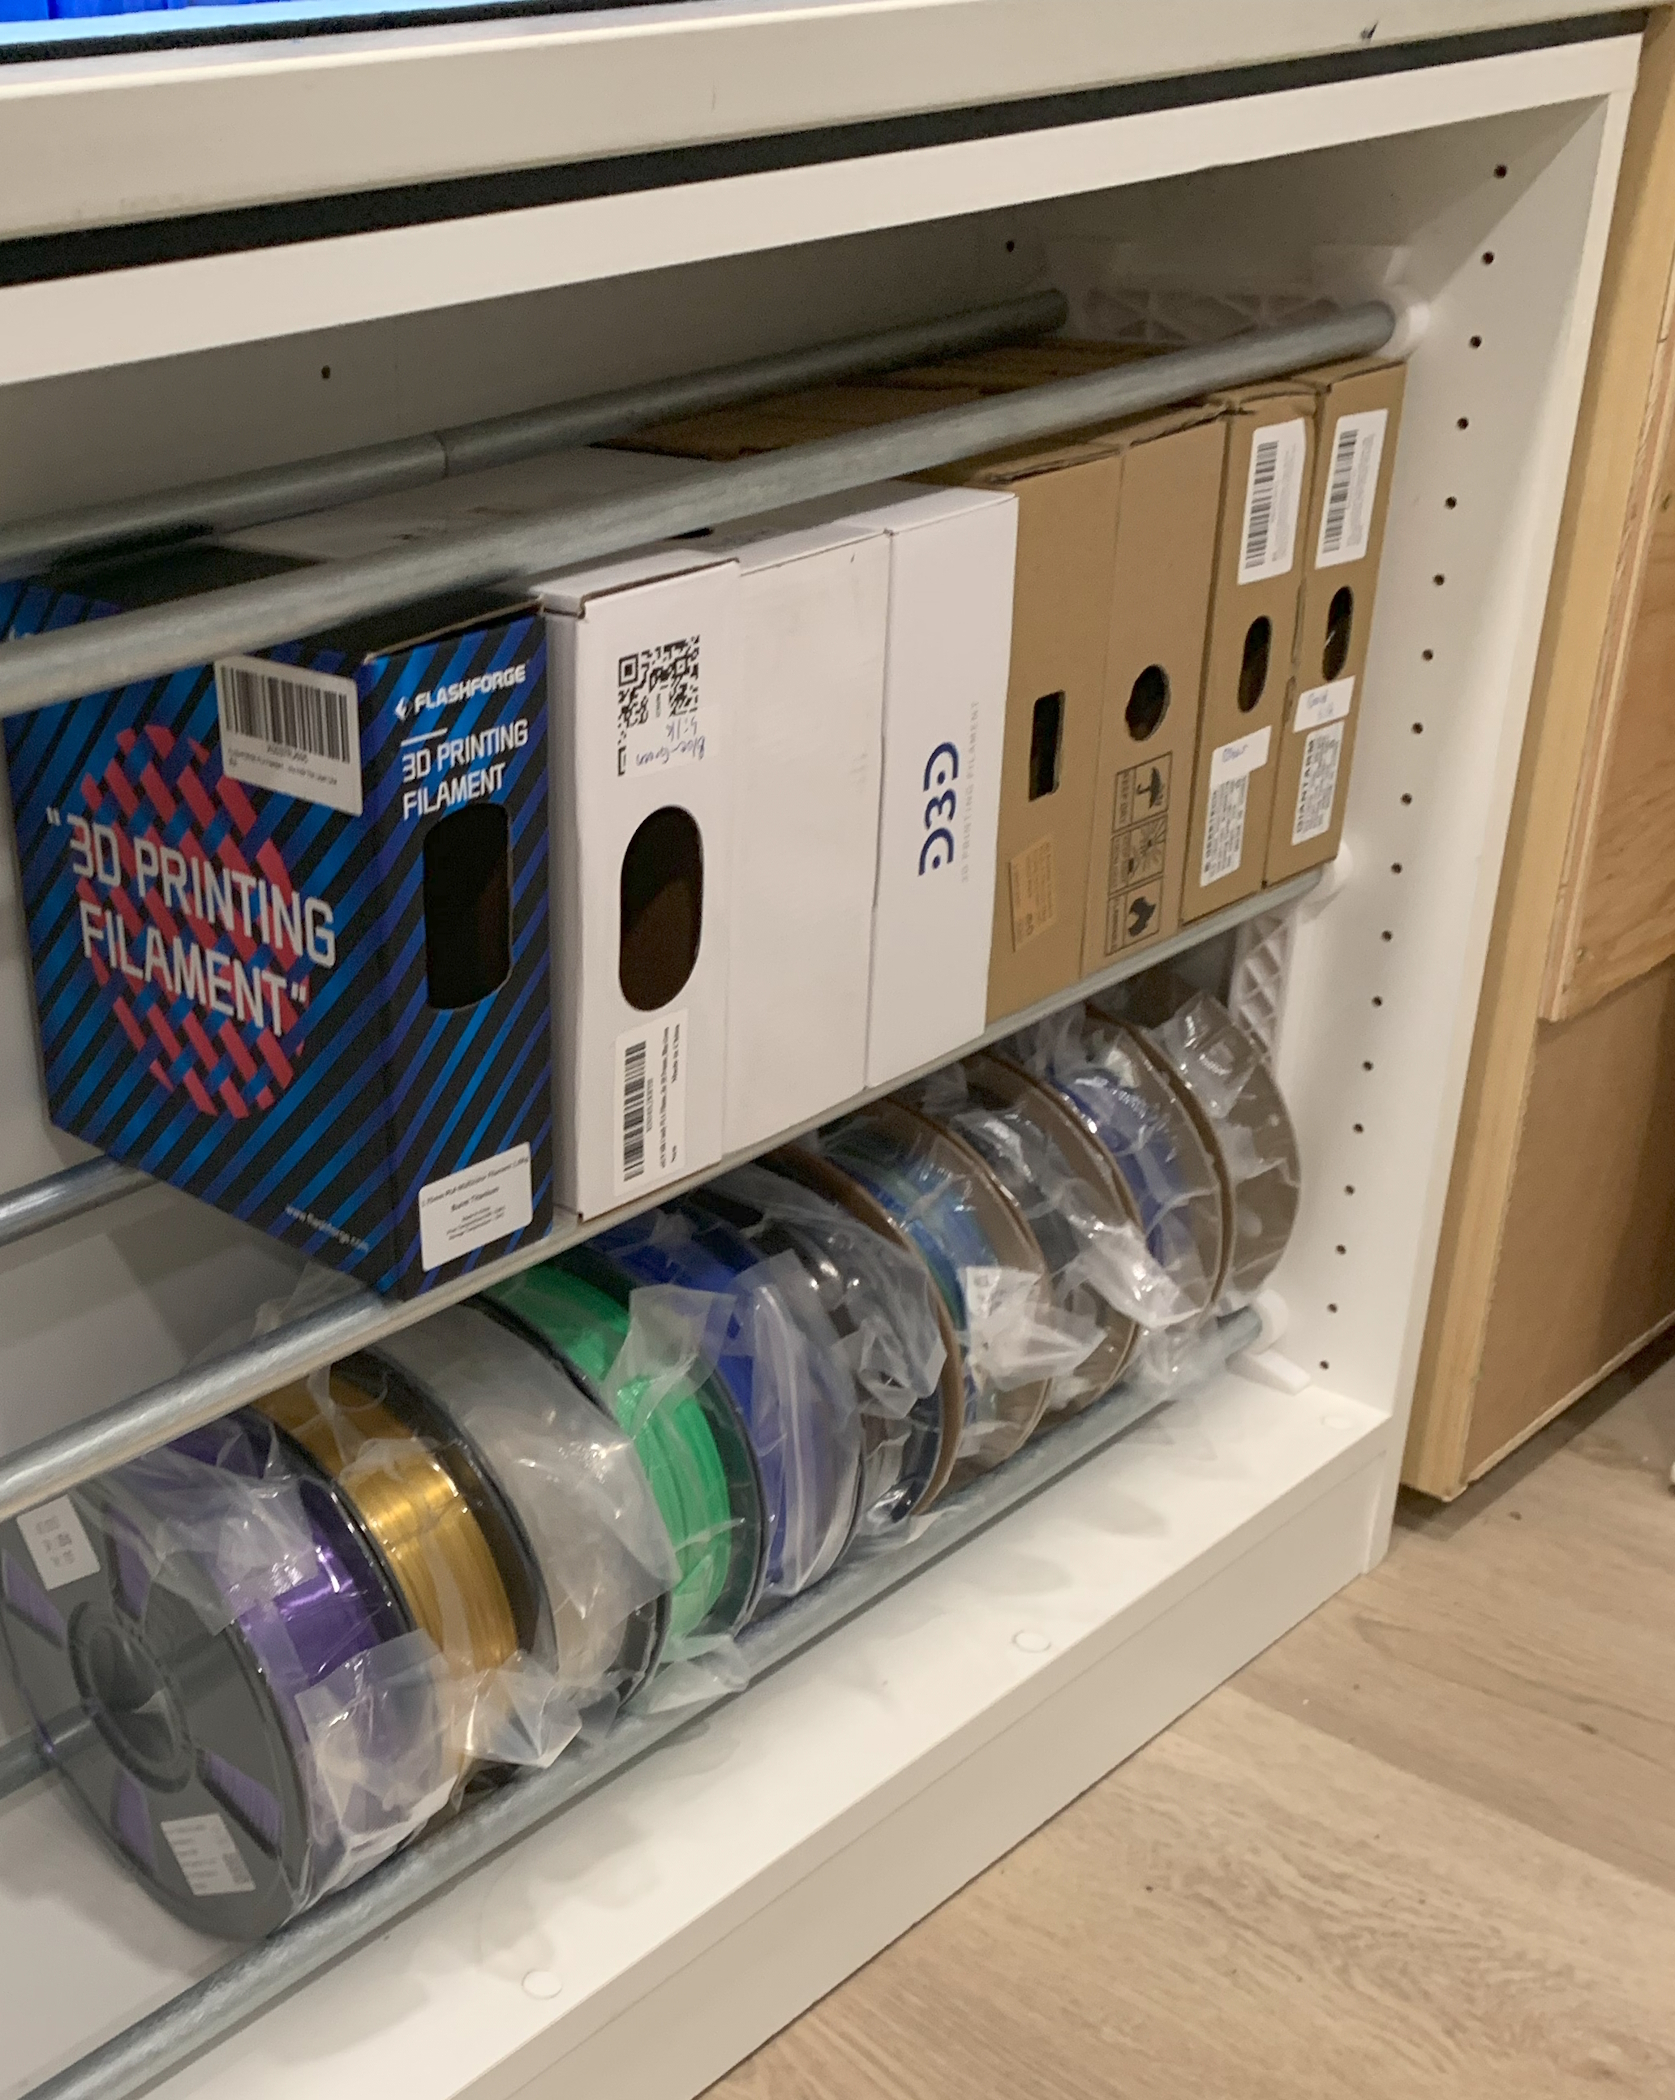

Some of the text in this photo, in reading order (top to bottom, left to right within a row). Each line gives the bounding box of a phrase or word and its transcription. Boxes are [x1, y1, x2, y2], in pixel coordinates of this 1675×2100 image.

[413, 663, 526, 715] FLASHFORGE
[402, 718, 529, 783] 3D PRINTING
[965, 700, 980, 780] FILAMENT
[403, 762, 506, 821] FILAMENT
[918, 741, 960, 876] D3D
[961, 784, 975, 861] PRINTING
[135, 837, 338, 968] PRINTING
